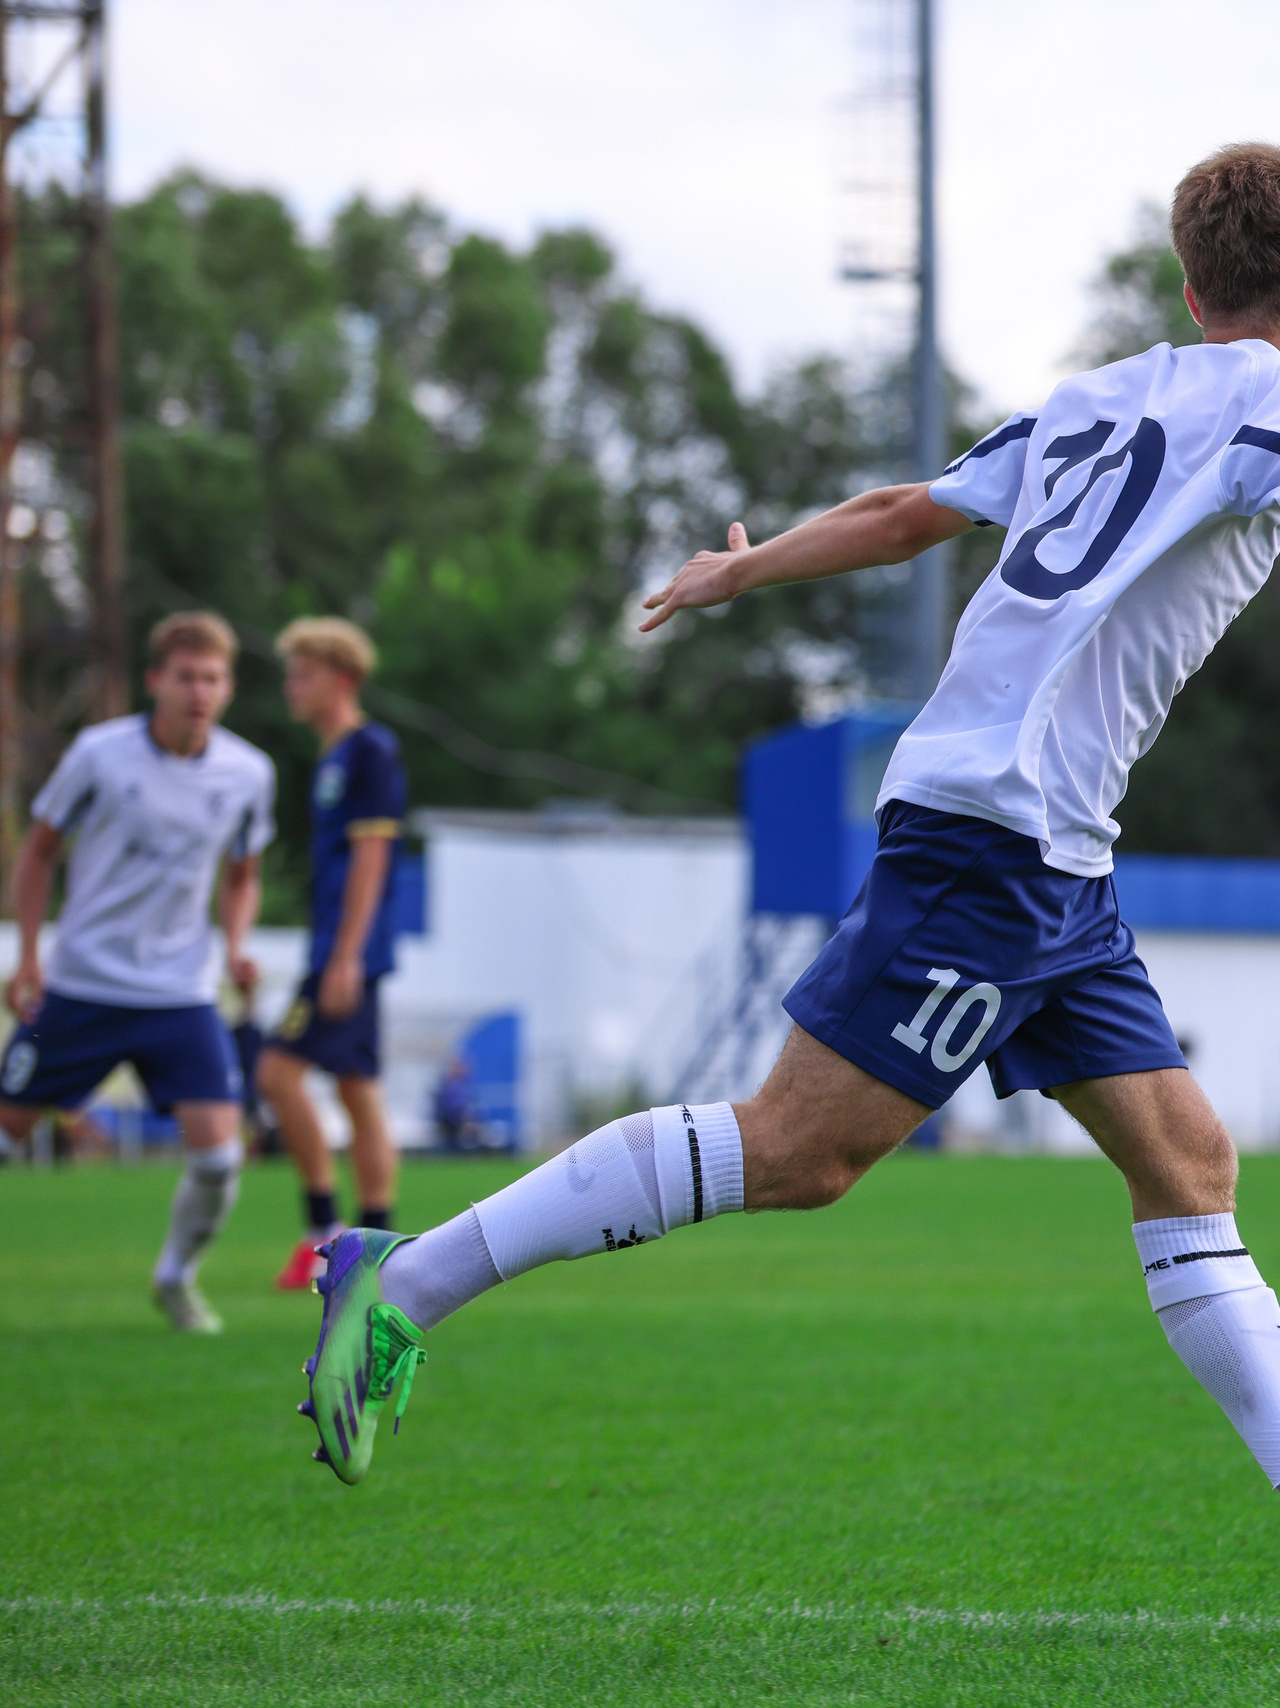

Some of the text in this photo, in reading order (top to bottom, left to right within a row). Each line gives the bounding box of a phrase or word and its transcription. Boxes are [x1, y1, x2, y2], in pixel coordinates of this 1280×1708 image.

[1000, 416, 1166, 601] 10
[890, 967, 1002, 1073] 10
[1144, 1257, 1171, 1276] ME
